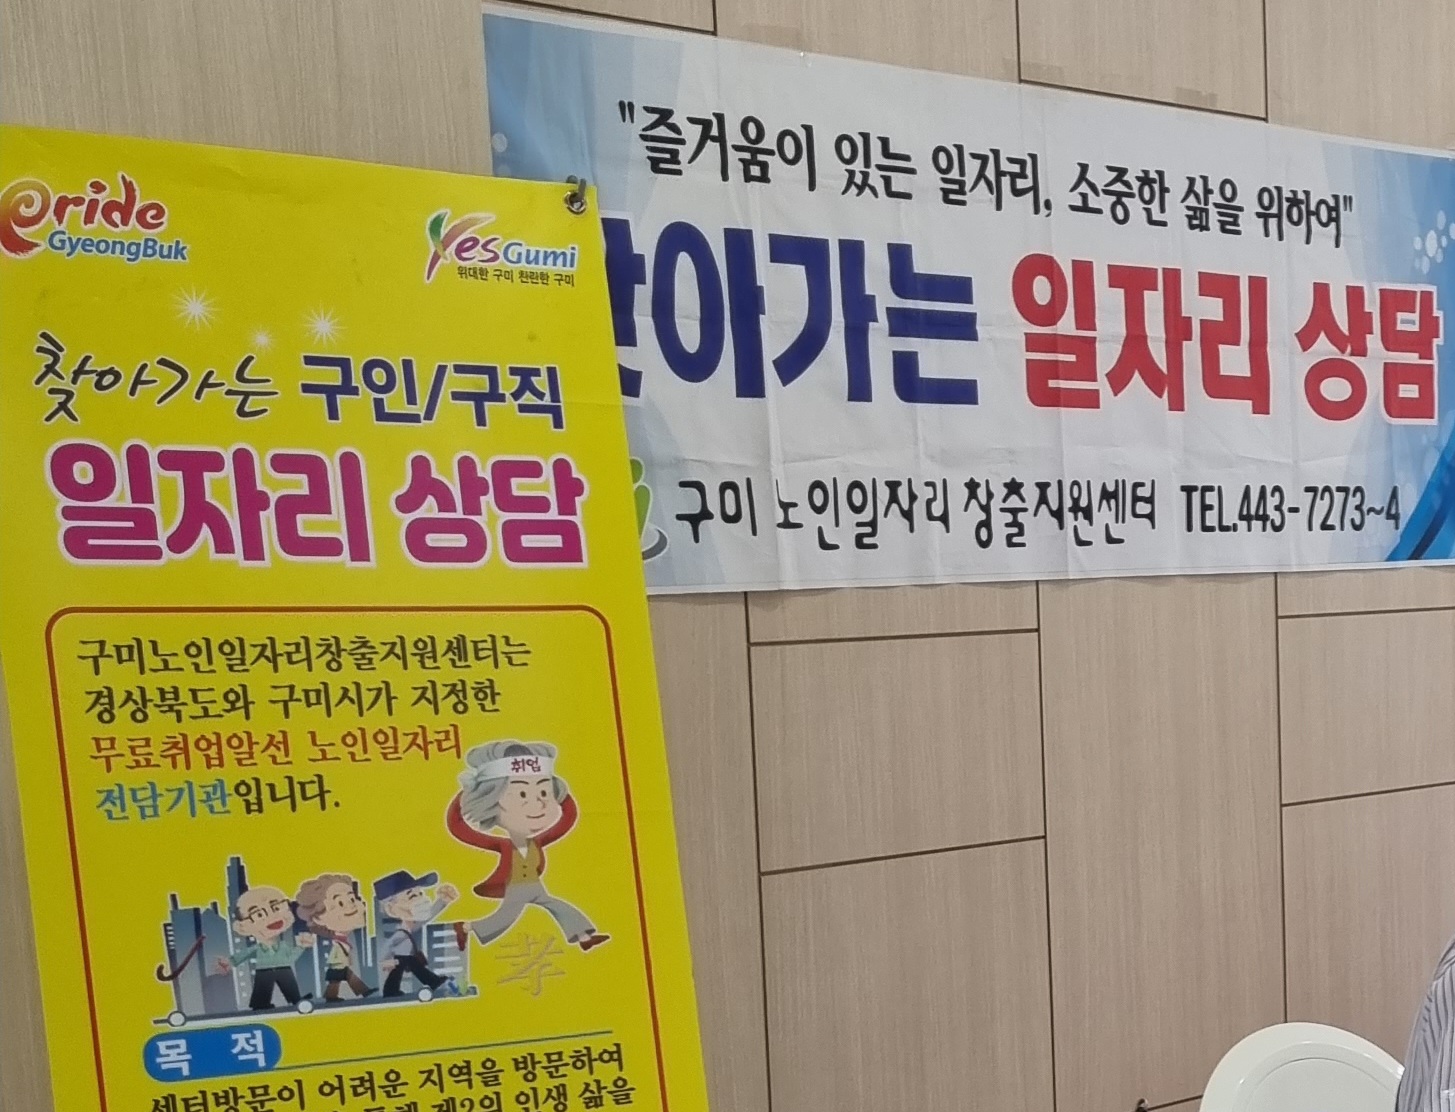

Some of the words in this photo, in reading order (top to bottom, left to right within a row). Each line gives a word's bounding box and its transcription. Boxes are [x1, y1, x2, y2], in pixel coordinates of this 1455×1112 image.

[618, 99, 817, 192] "즐거움이
[835, 132, 917, 201] 있는
[932, 142, 1054, 217] 일자리,
[1068, 160, 1170, 228] 소중한
[1180, 175, 1245, 237] 삶을
[1255, 185, 1353, 248] 위하여"
[48, 231, 187, 262] GyeongBuk
[457, 266, 489, 281] 위대한
[493, 269, 514, 283] 구미
[554, 274, 575, 287] 구미
[1012, 252, 1272, 416] 일자리
[1295, 282, 1441, 421] 상담
[34, 332, 278, 422] 찾아가는
[301, 355, 563, 430] 구인/구직
[50, 444, 371, 562] 일자리
[394, 455, 588, 563] 상담
[676, 478, 758, 544] 구미
[774, 477, 951, 552] 노인일자리
[963, 477, 1156, 549] 창출지원센터
[78, 634, 532, 677] 구미노인일자리창출지원센터는
[85, 684, 254, 724] 경상북도와
[268, 681, 399, 719] 구미시가
[411, 677, 501, 716] 지정한
[91, 728, 292, 774] 무료취업알선
[307, 724, 463, 763] 노인일자리
[511, 757, 541, 774] 취업
[96, 773, 340, 822] 전담기관입니다.
[318, 1068, 408, 1106] 어려운
[418, 1057, 505, 1093] 지역을
[512, 1043, 623, 1083] 방문하여
[578, 1076, 636, 1110] 삶을
